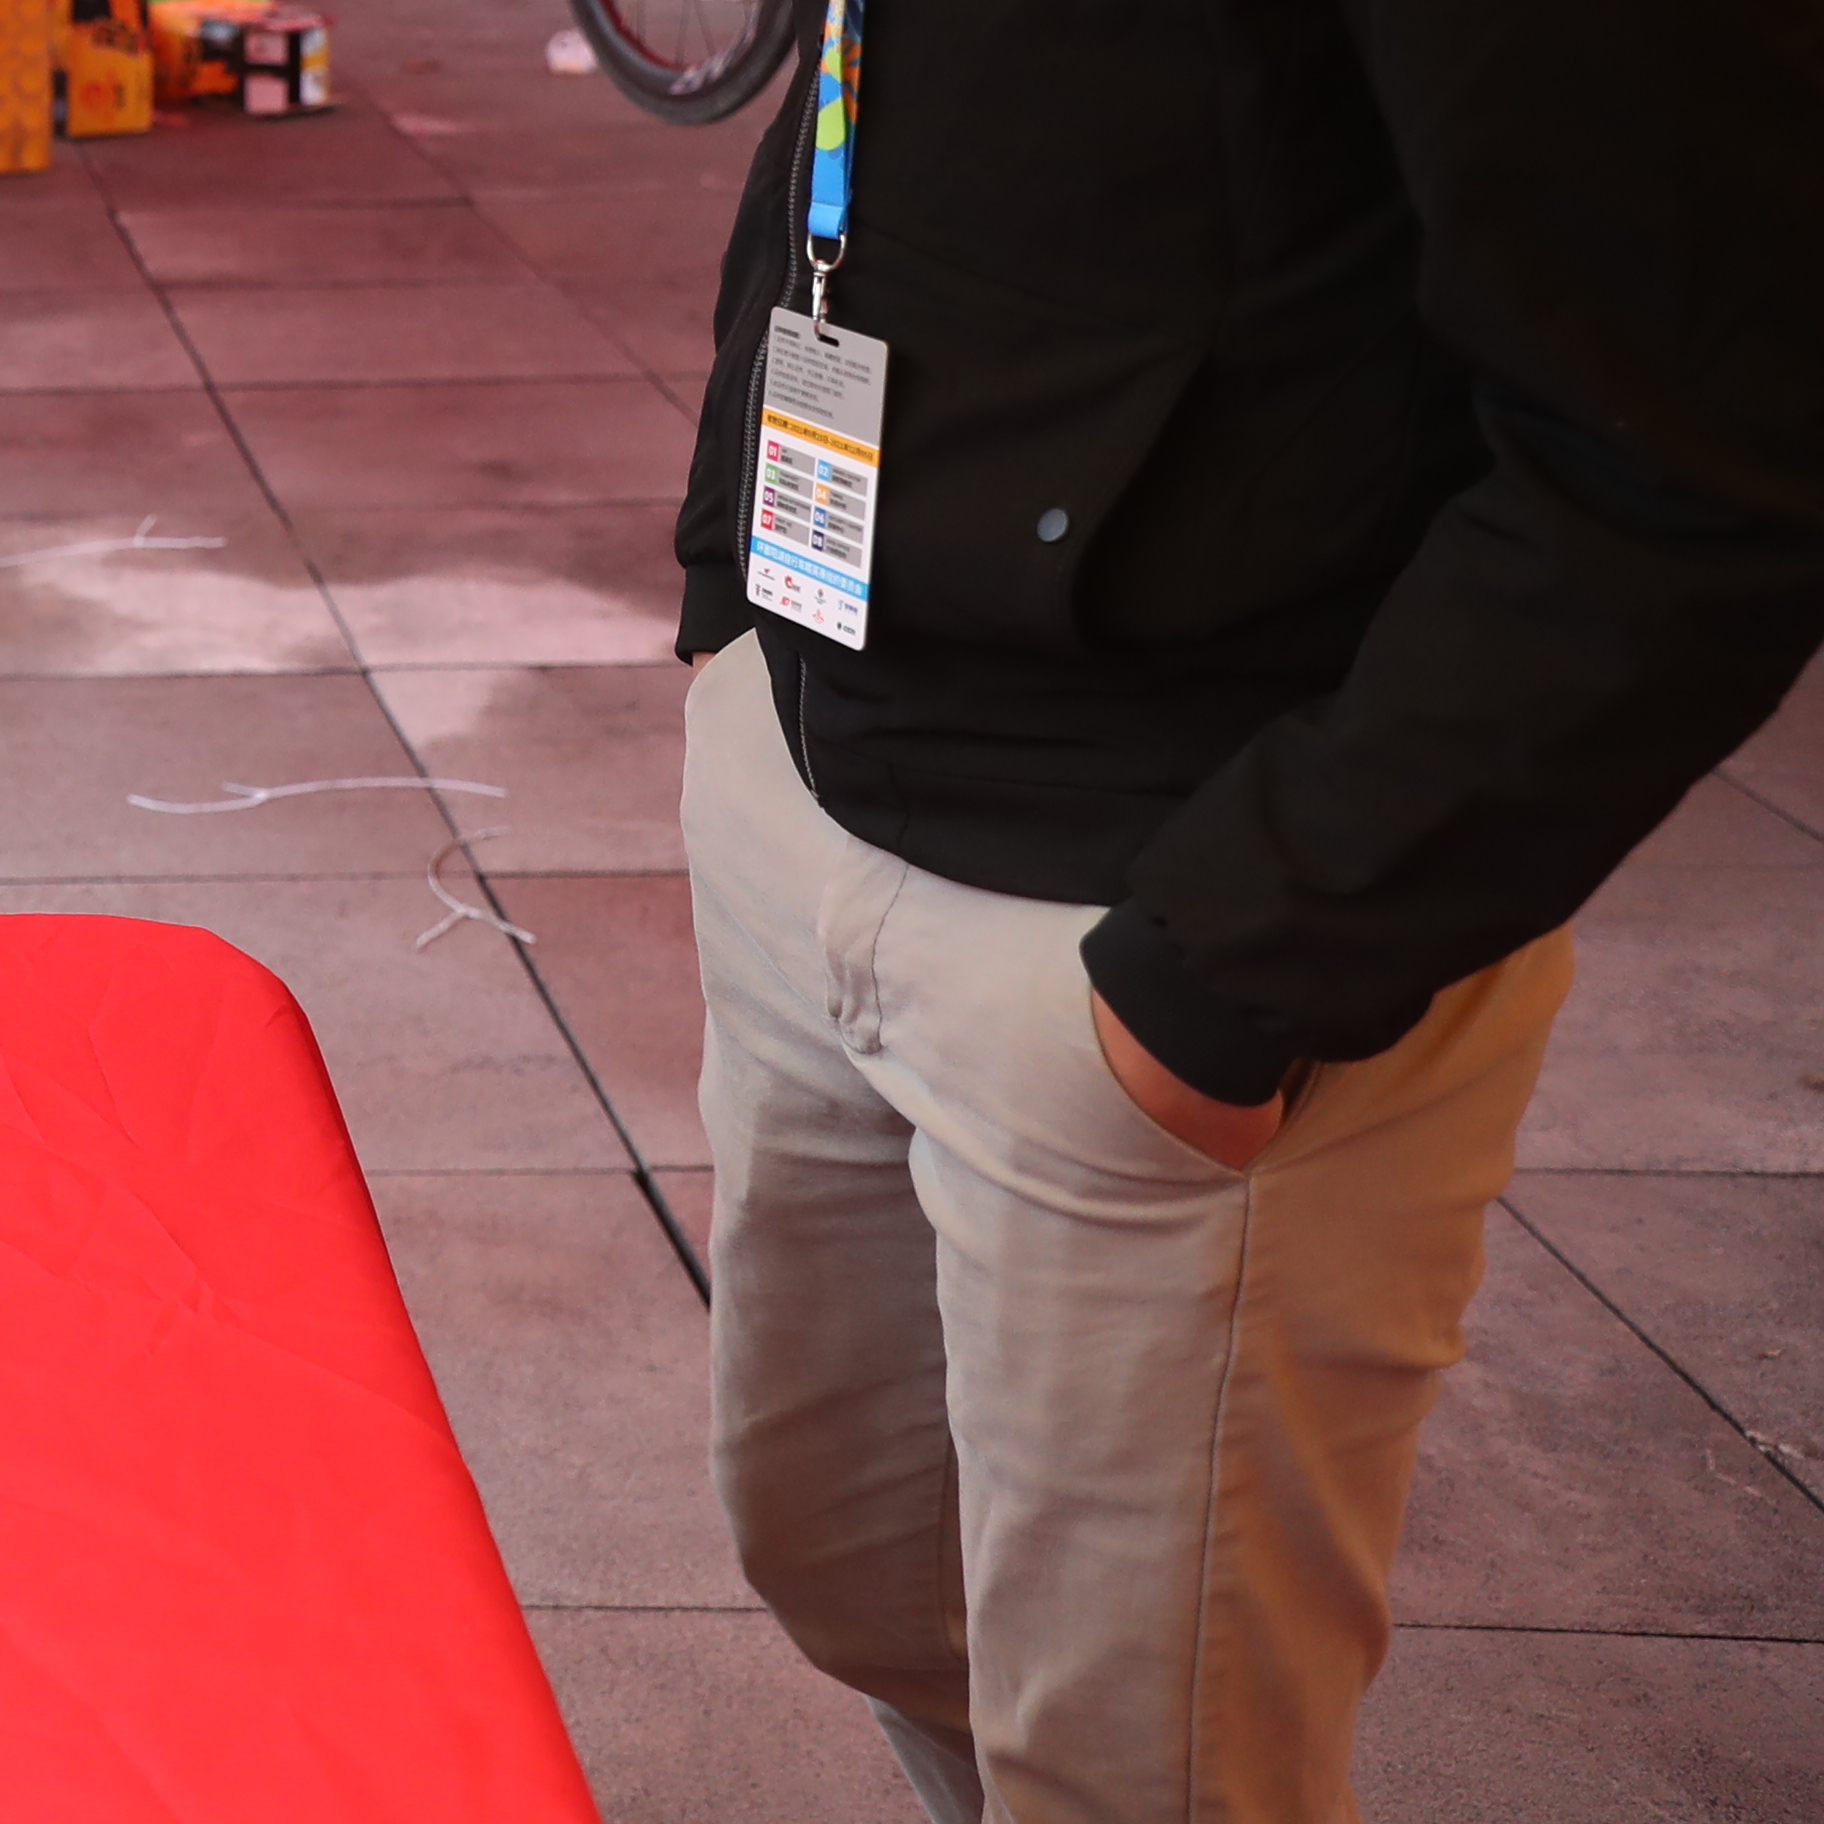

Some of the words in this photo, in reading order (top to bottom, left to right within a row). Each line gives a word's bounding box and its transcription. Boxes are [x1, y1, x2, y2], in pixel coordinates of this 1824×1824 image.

[768, 444, 778, 457] 01
[766, 467, 776, 480] 03
[818, 463, 829, 476] 02
[764, 490, 774, 503] 05
[816, 487, 826, 502] 04
[762, 513, 772, 526] 07
[814, 510, 825, 524] 06
[812, 534, 823, 548] 08
